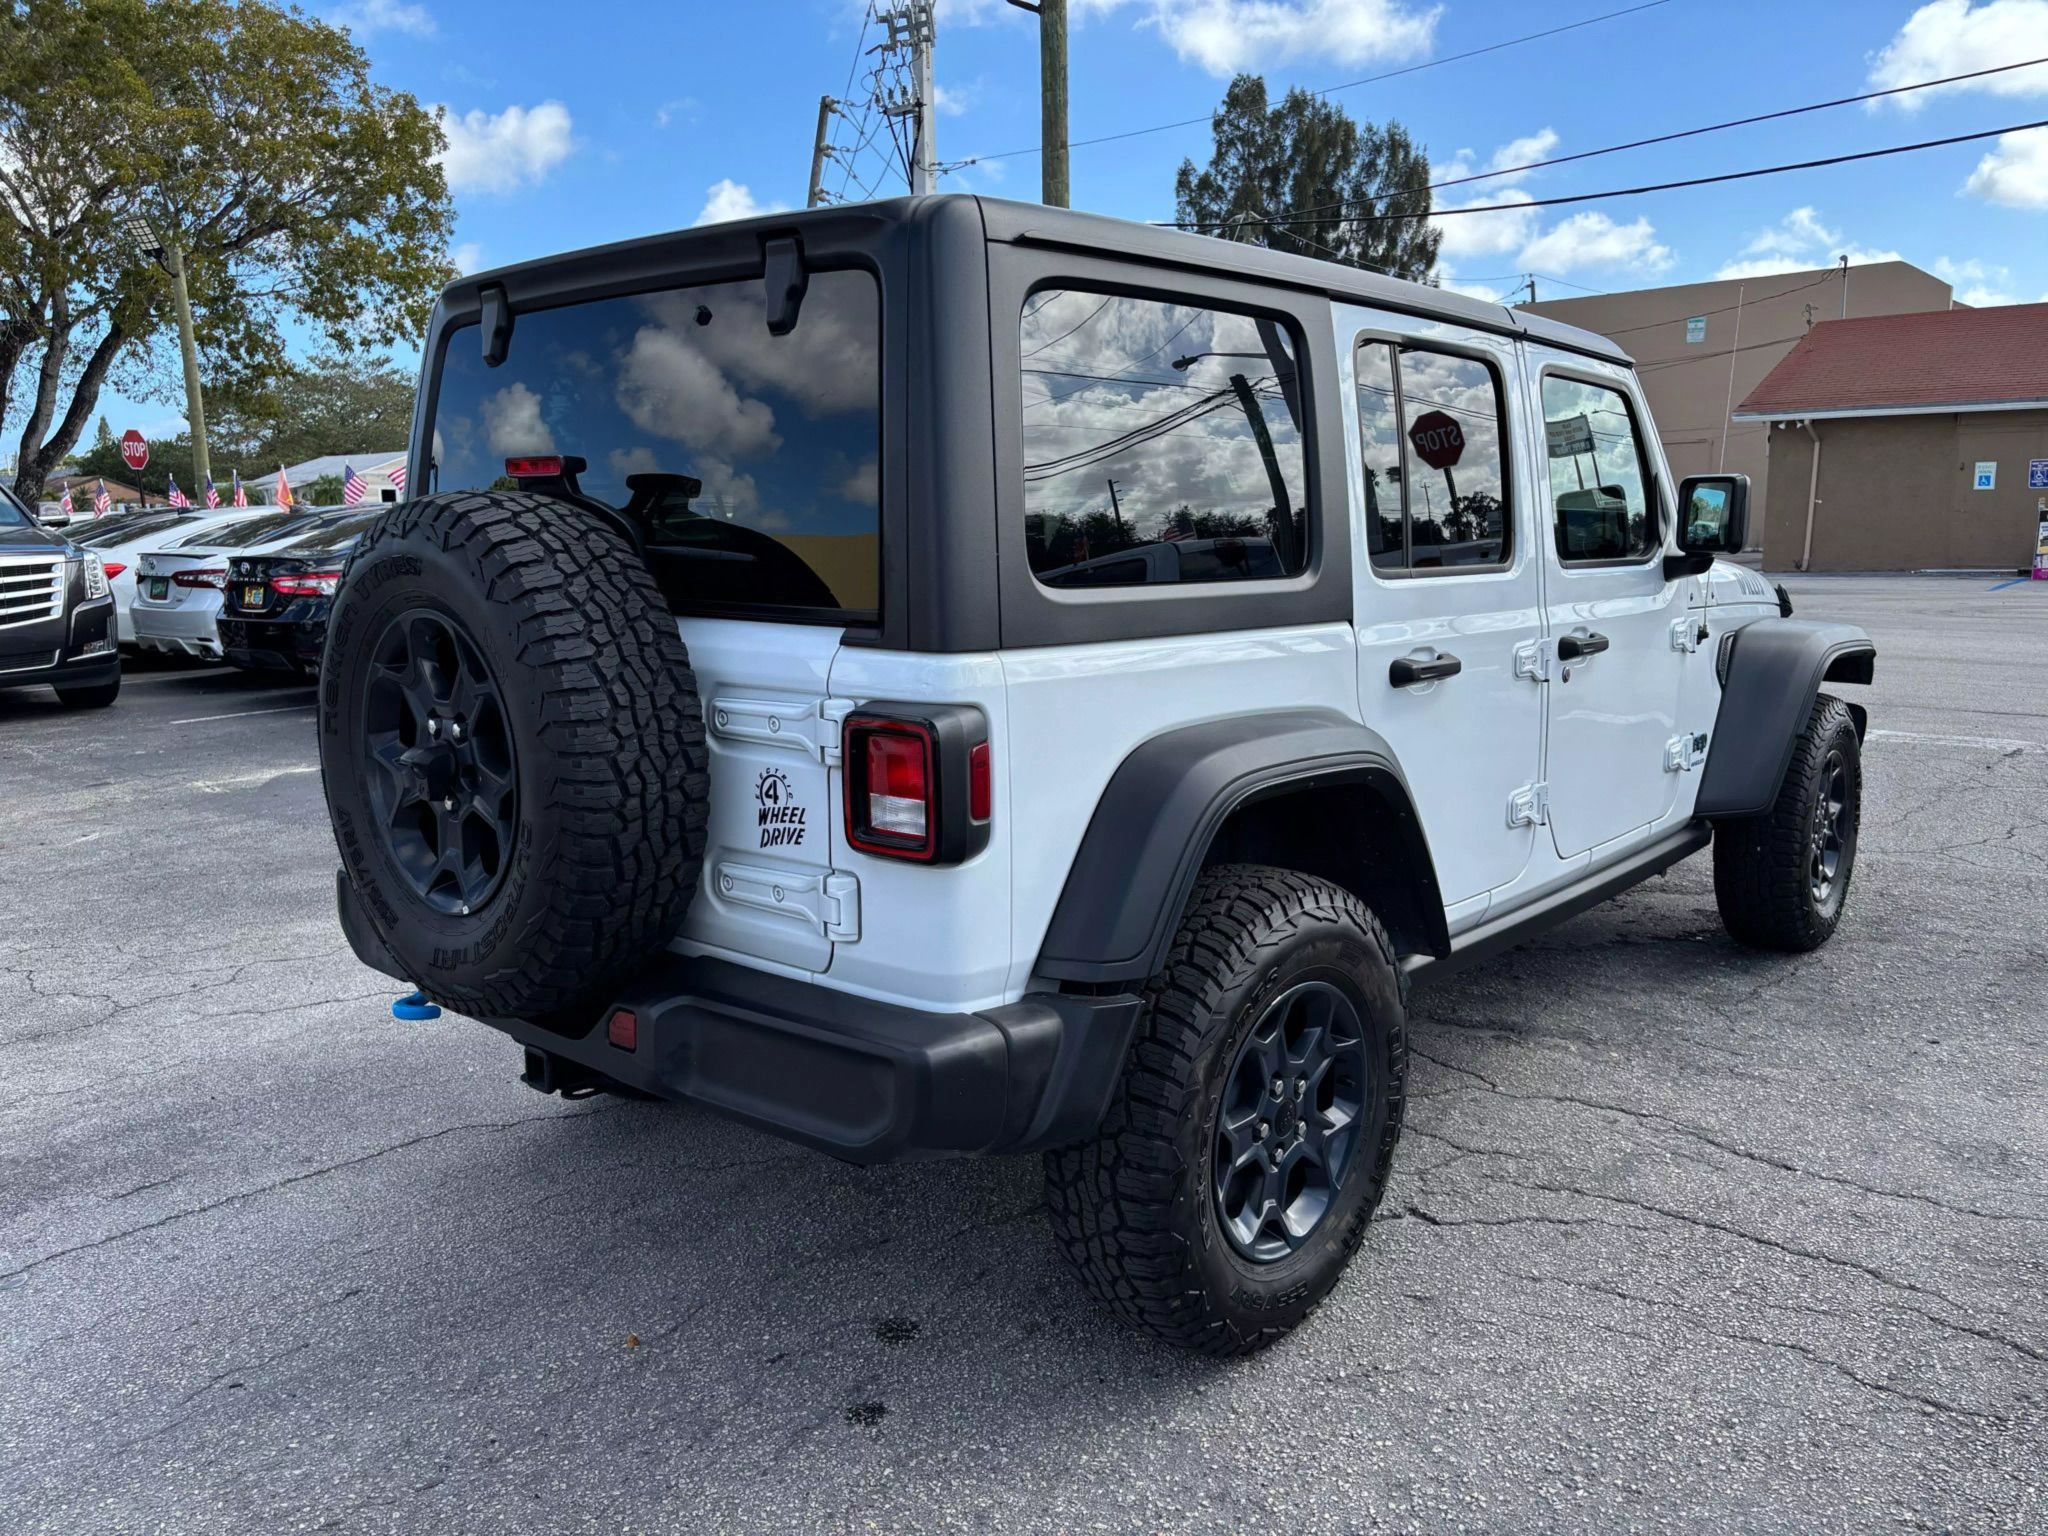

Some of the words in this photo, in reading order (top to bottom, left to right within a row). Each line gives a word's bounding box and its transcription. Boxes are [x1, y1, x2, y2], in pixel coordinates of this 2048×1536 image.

[123, 441, 146, 457] STOP
[755, 767, 793, 800] ELECTRIC
[764, 779, 779, 805] 4
[758, 806, 806, 827] WHEEL
[760, 826, 806, 849] DRIVE
